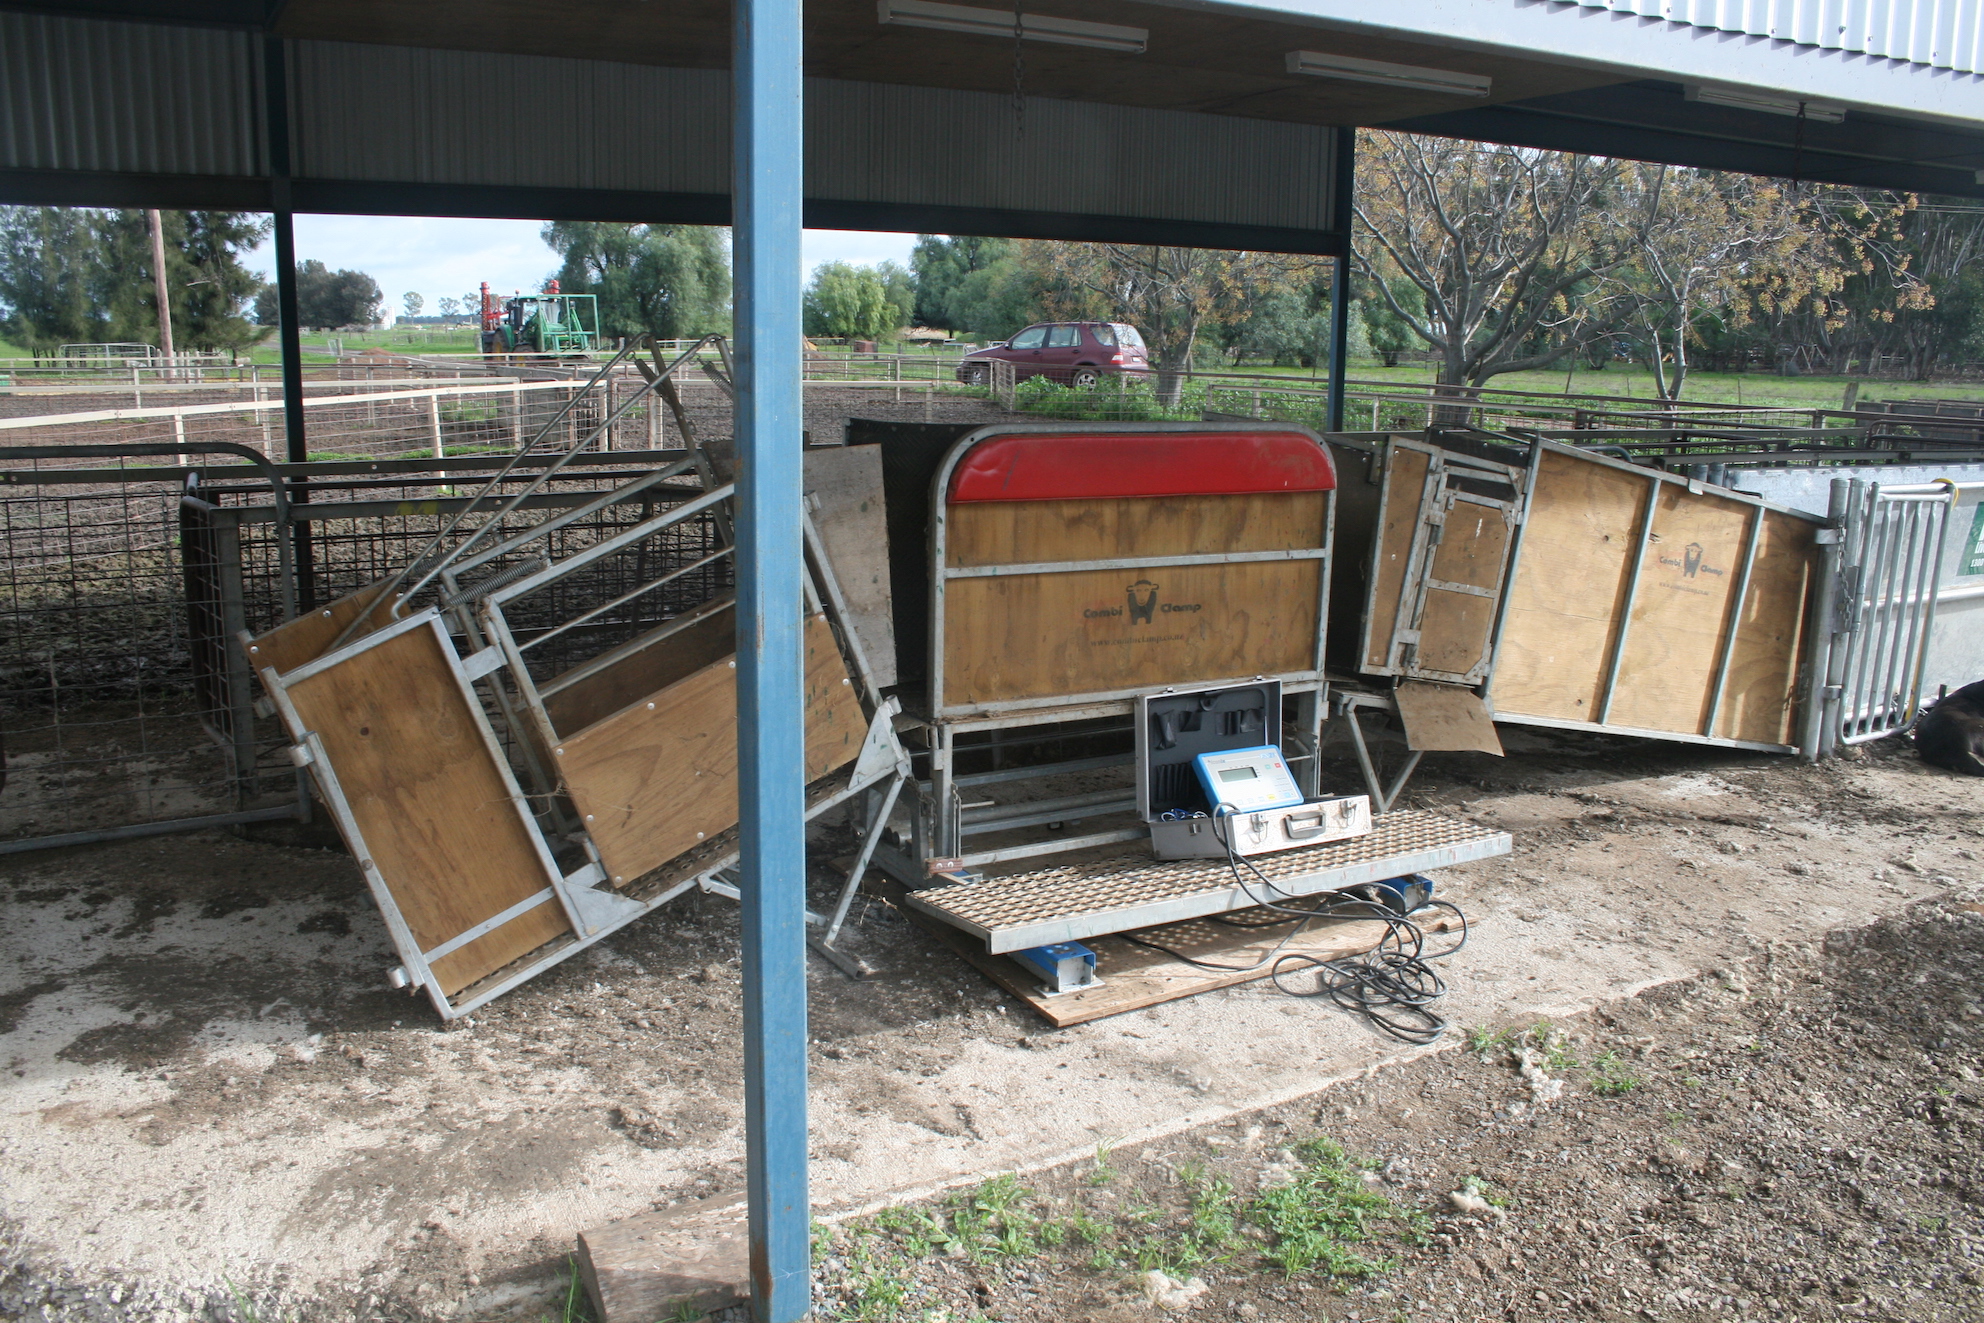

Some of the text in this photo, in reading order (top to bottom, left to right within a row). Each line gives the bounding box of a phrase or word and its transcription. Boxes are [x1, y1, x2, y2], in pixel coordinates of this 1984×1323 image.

[1659, 556, 1724, 577] Combi Clamp
[1083, 603, 1202, 619] Combi Clamp
